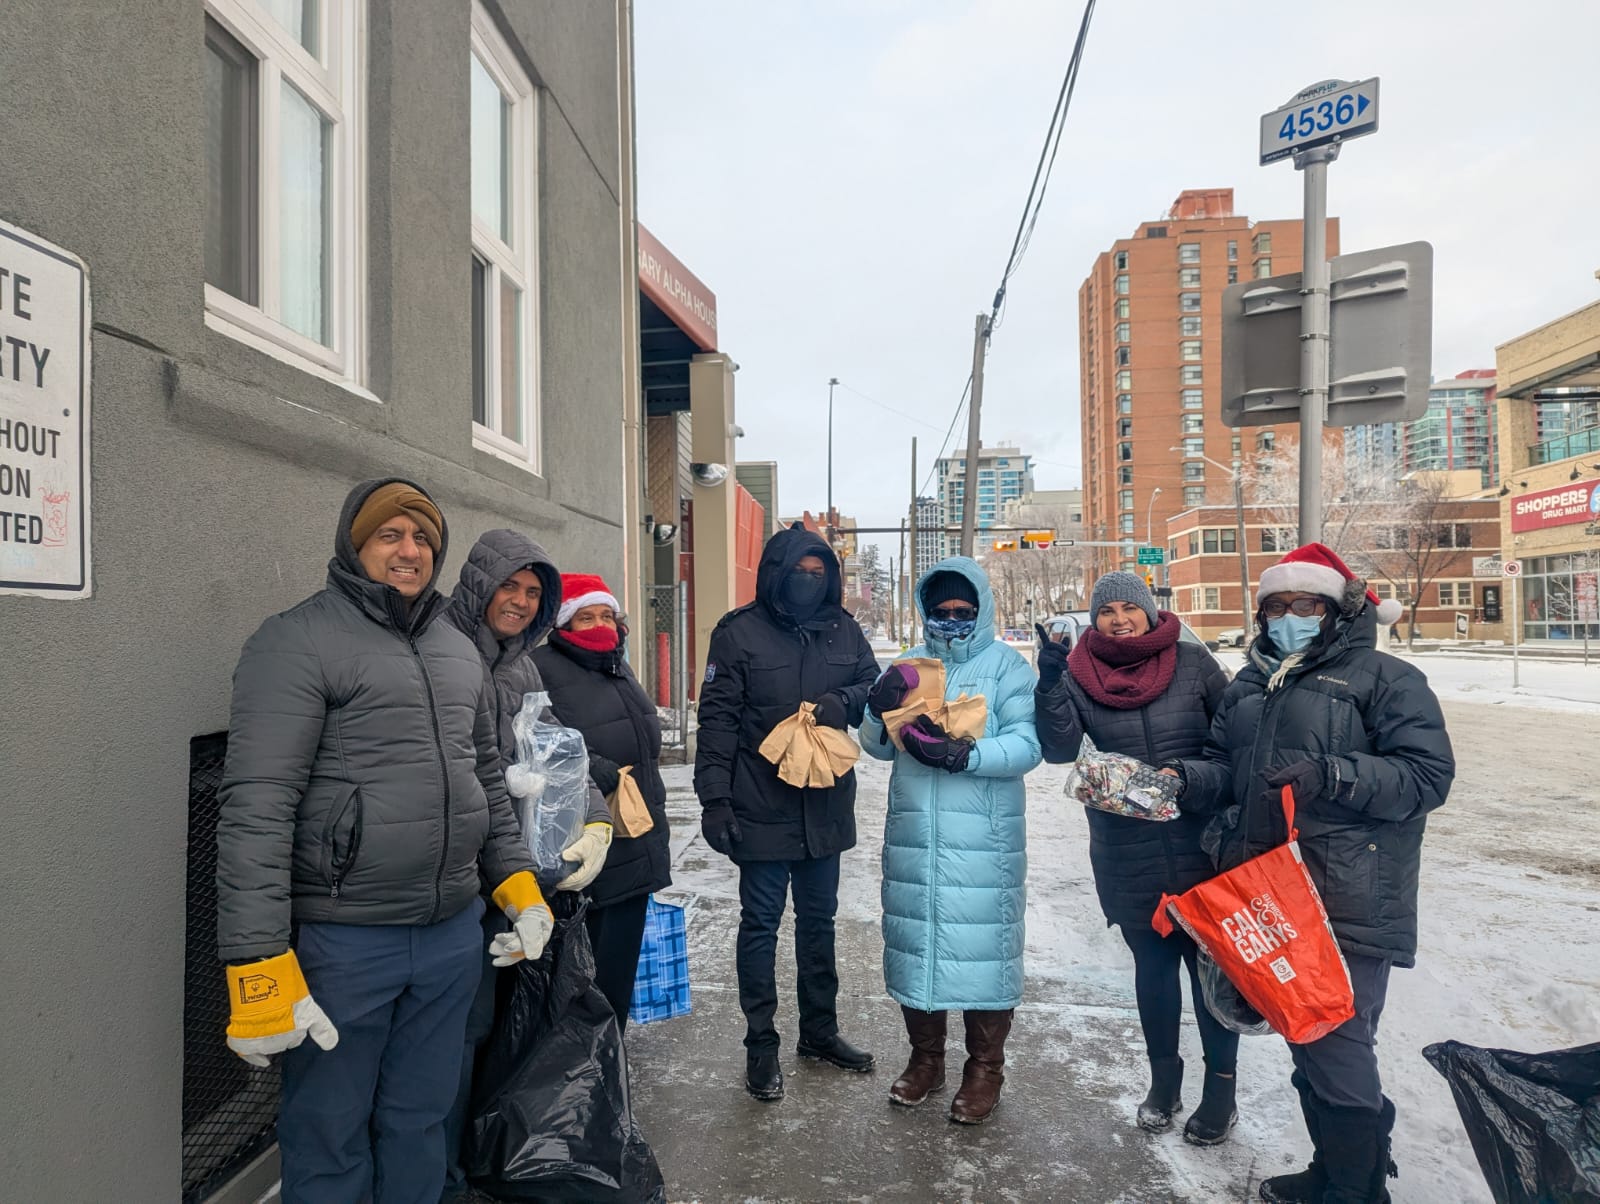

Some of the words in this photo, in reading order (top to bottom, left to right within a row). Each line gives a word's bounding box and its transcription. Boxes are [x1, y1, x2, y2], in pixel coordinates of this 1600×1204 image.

[1278, 94, 1354, 141] 4536
[638, 248, 661, 284] ARY
[663, 267, 693, 311] ALPHA
[694, 295, 717, 330] HOUS
[0, 335, 50, 388] TY
[0, 417, 61, 459] HOUT
[0, 464, 31, 498] ON
[1516, 489, 1588, 515] SHOPPERS
[1542, 508, 1564, 520] DRUG
[1565, 504, 1588, 516] MART
[0, 510, 43, 544] TED
[1221, 907, 1259, 942] CAL
